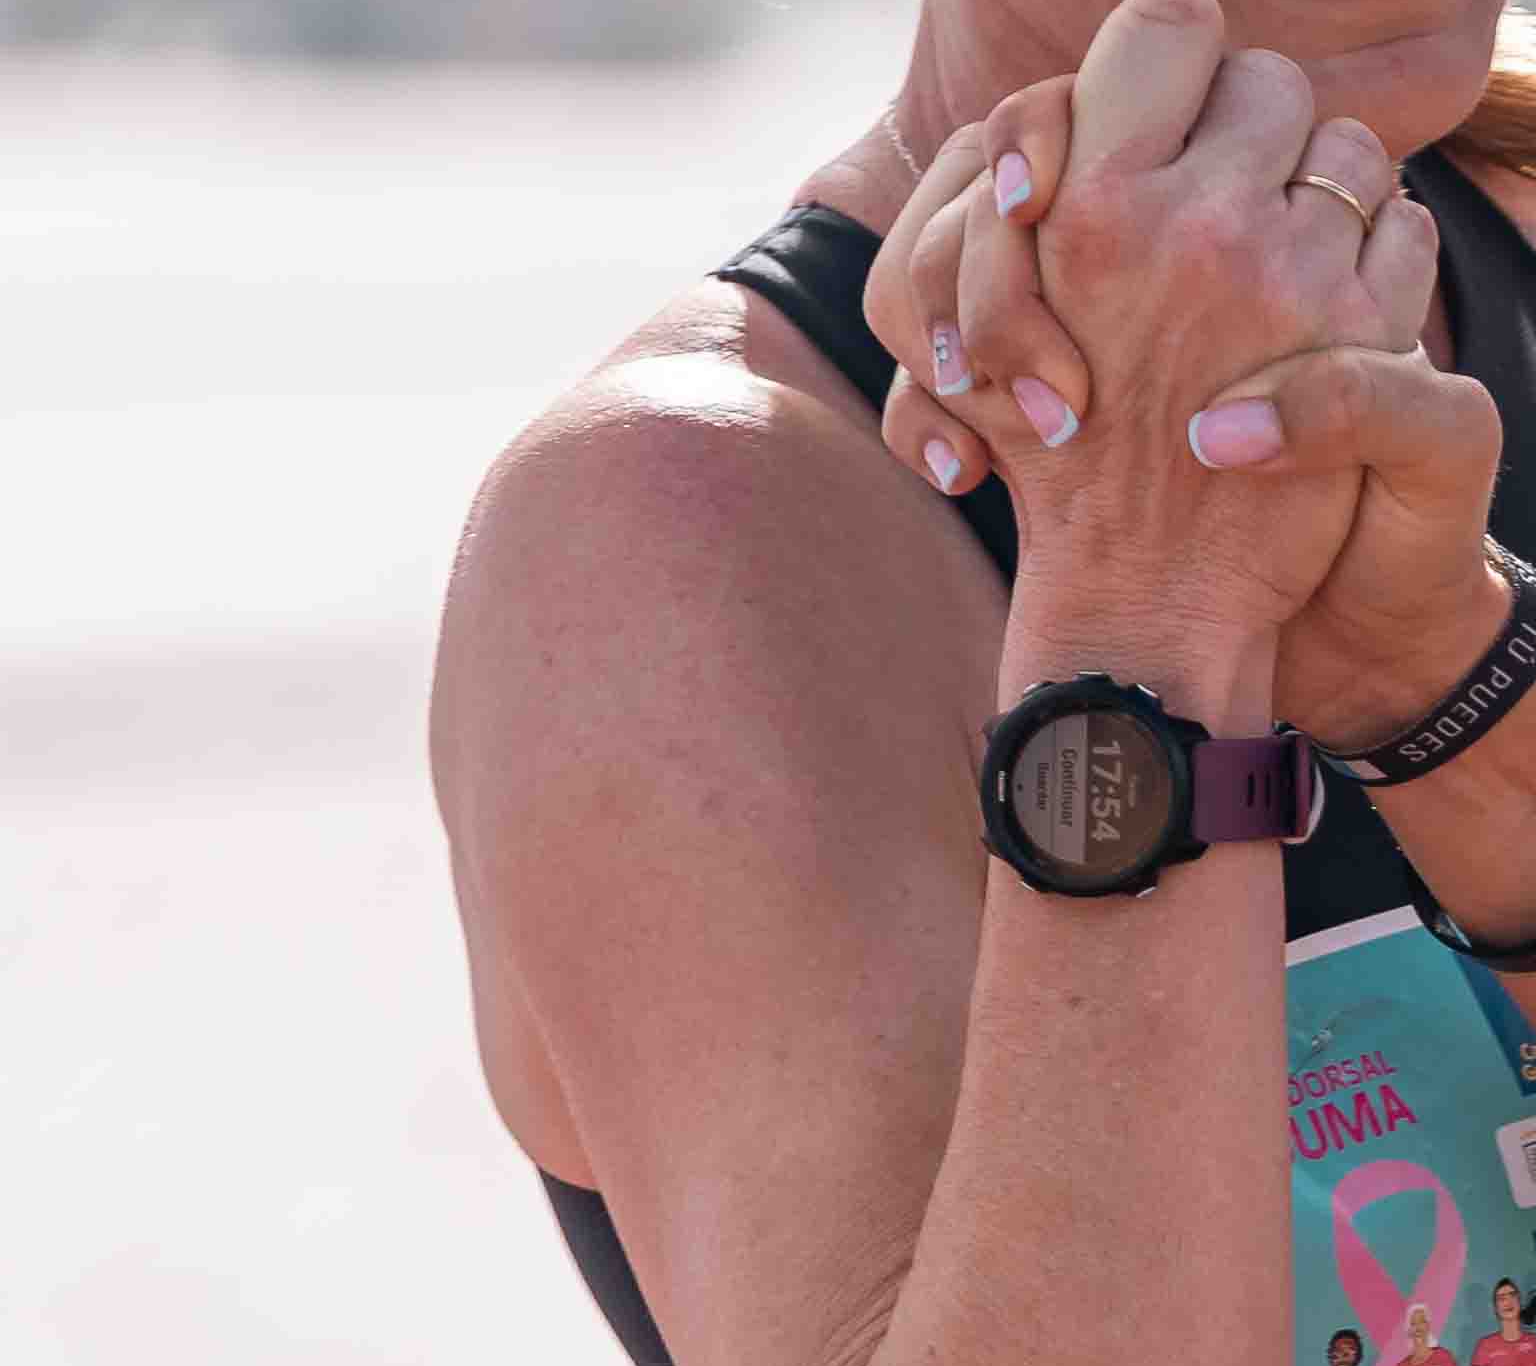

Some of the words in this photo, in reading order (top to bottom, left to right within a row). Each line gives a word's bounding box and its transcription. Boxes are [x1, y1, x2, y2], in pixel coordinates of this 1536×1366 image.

[1397, 665, 1513, 762] PUEDES
[1059, 747, 1080, 828] Continuar
[1091, 740, 1123, 842] 17:54
[1288, 1084, 1420, 1160] UMA
